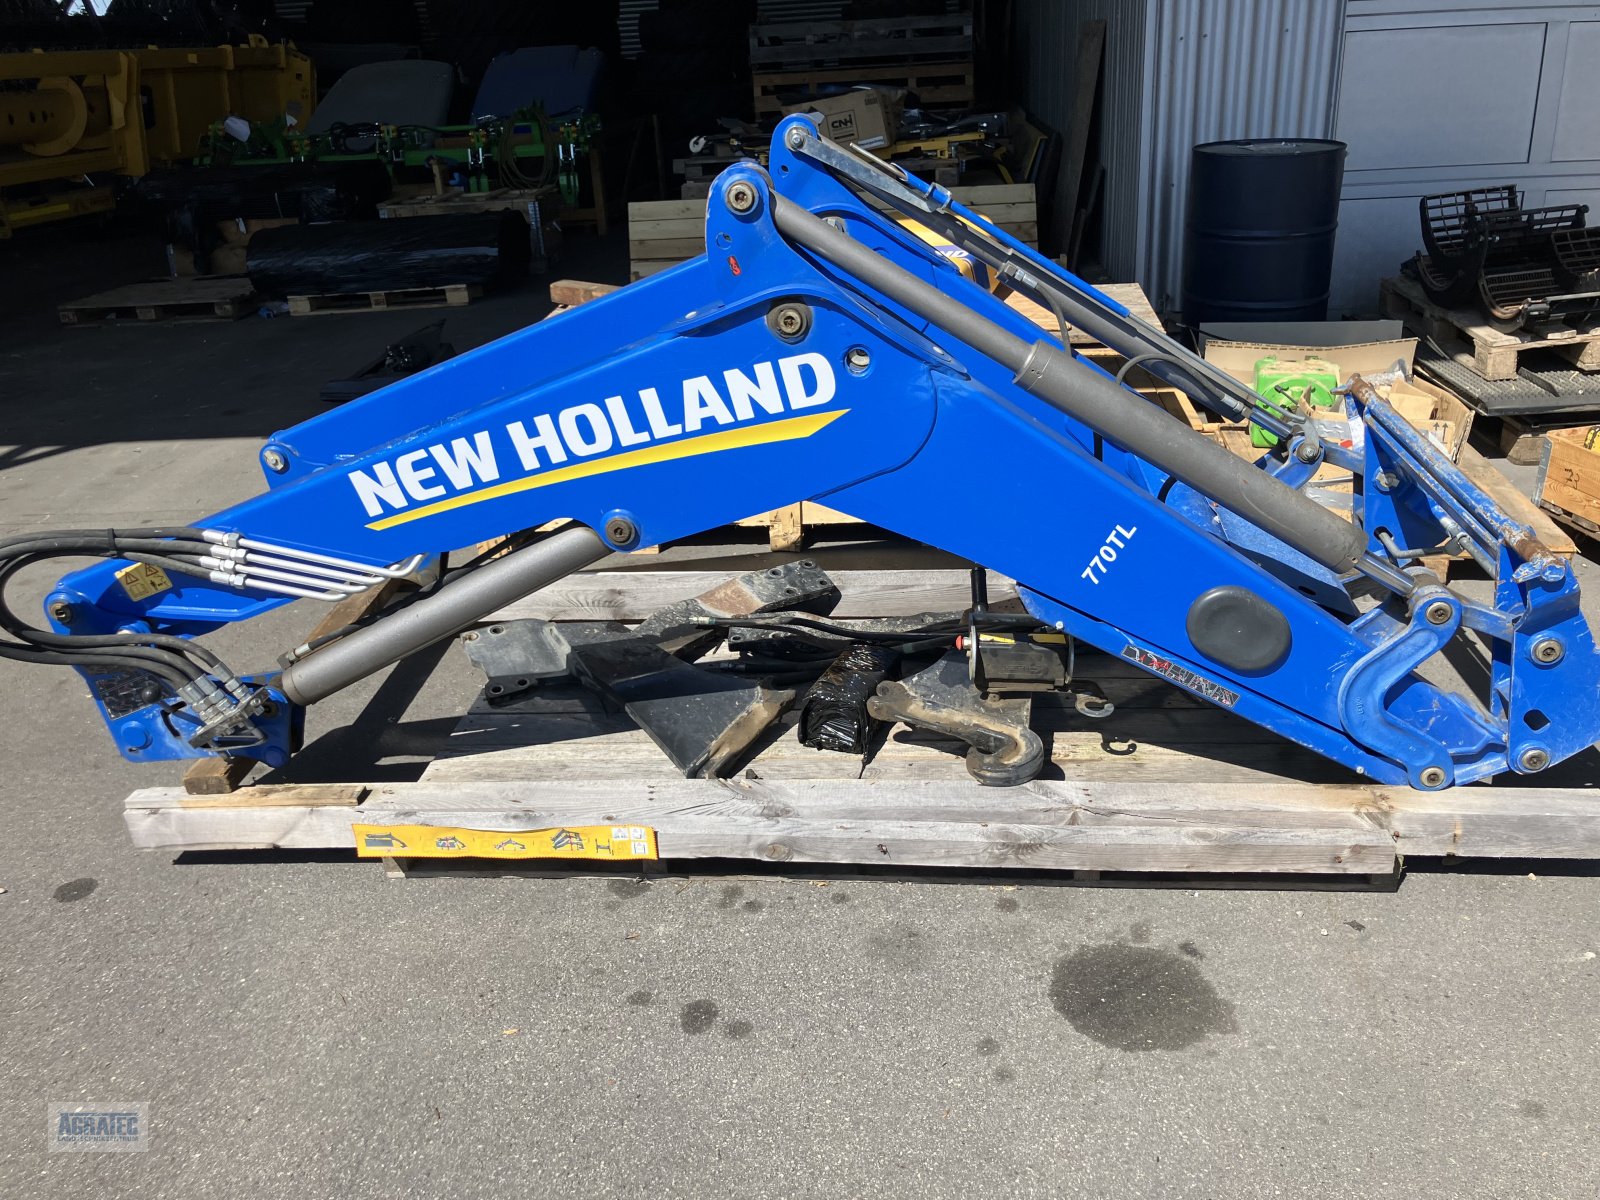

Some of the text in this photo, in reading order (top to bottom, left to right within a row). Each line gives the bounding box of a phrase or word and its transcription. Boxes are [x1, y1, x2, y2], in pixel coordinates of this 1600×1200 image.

[348, 352, 837, 517] NEW HOLLAND
[1081, 524, 1137, 585] 770TL
